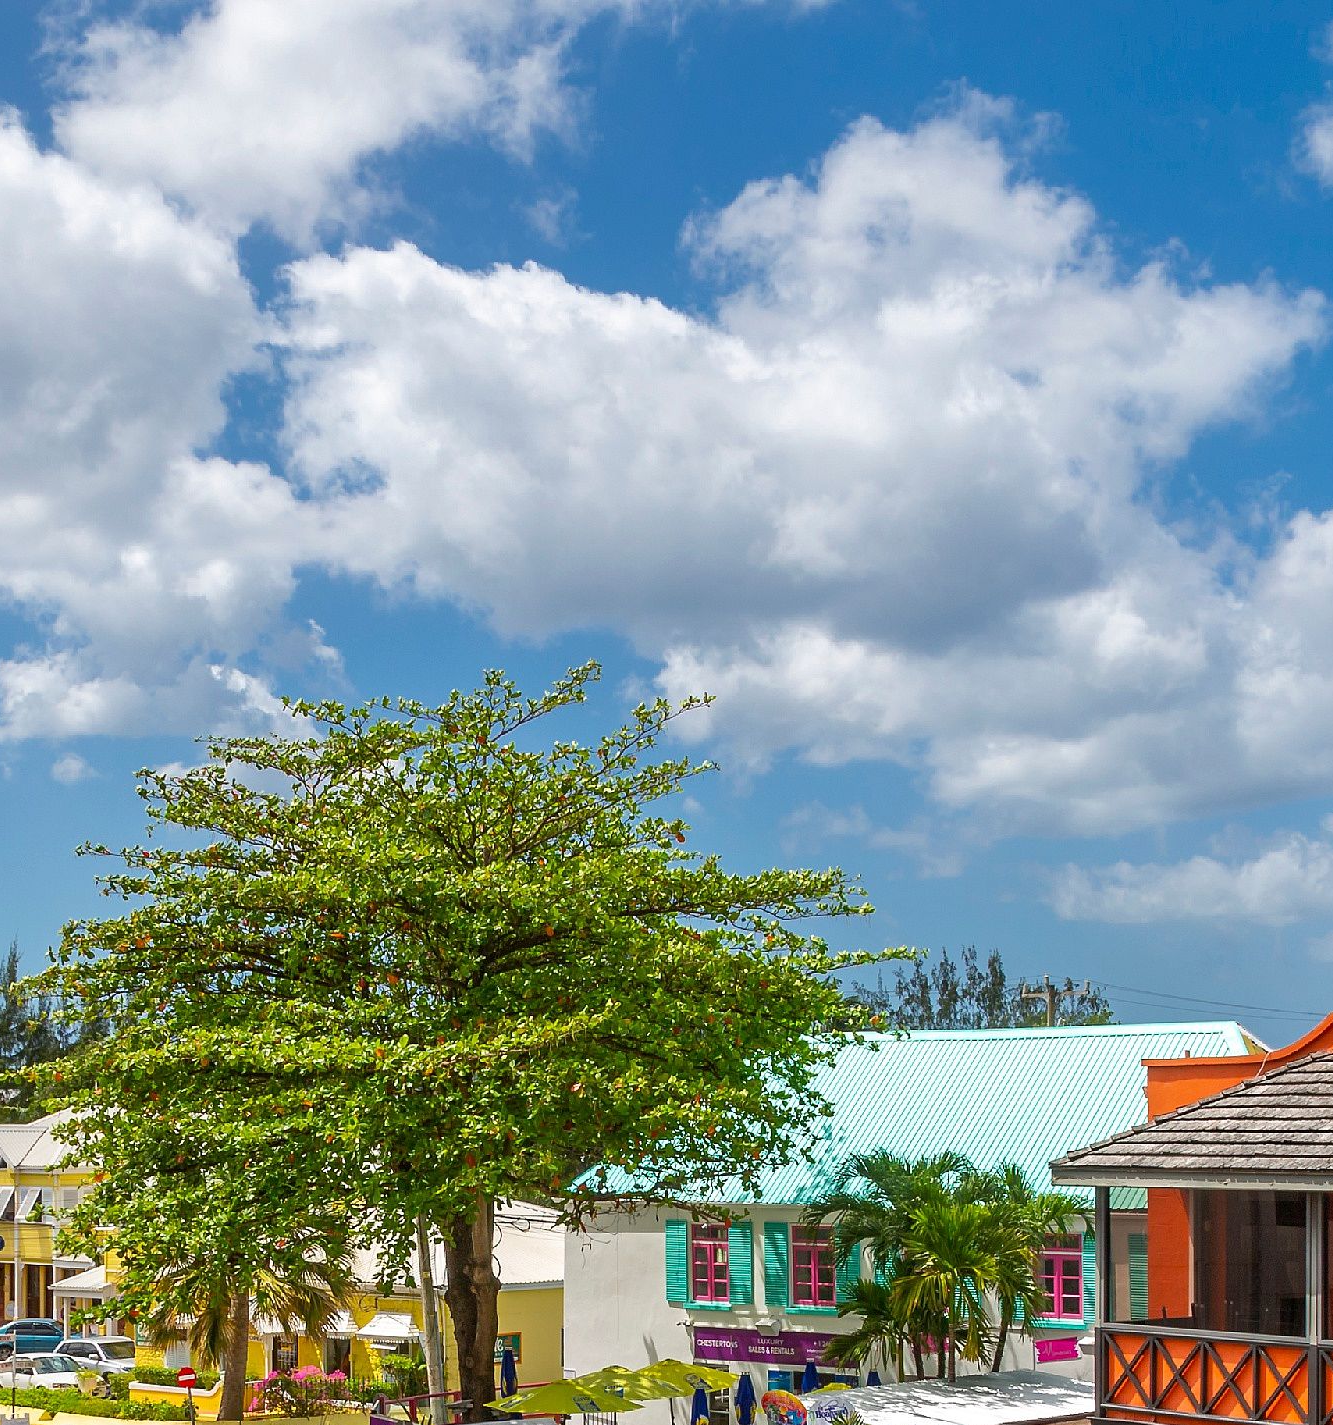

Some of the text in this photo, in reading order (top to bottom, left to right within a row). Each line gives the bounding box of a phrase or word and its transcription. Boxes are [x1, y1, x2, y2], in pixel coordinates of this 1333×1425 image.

[697, 1338, 739, 1349] CHESTERTONS
[757, 1338, 784, 1346] LUXURY
[747, 1345, 795, 1356] SALES & RENTALS
